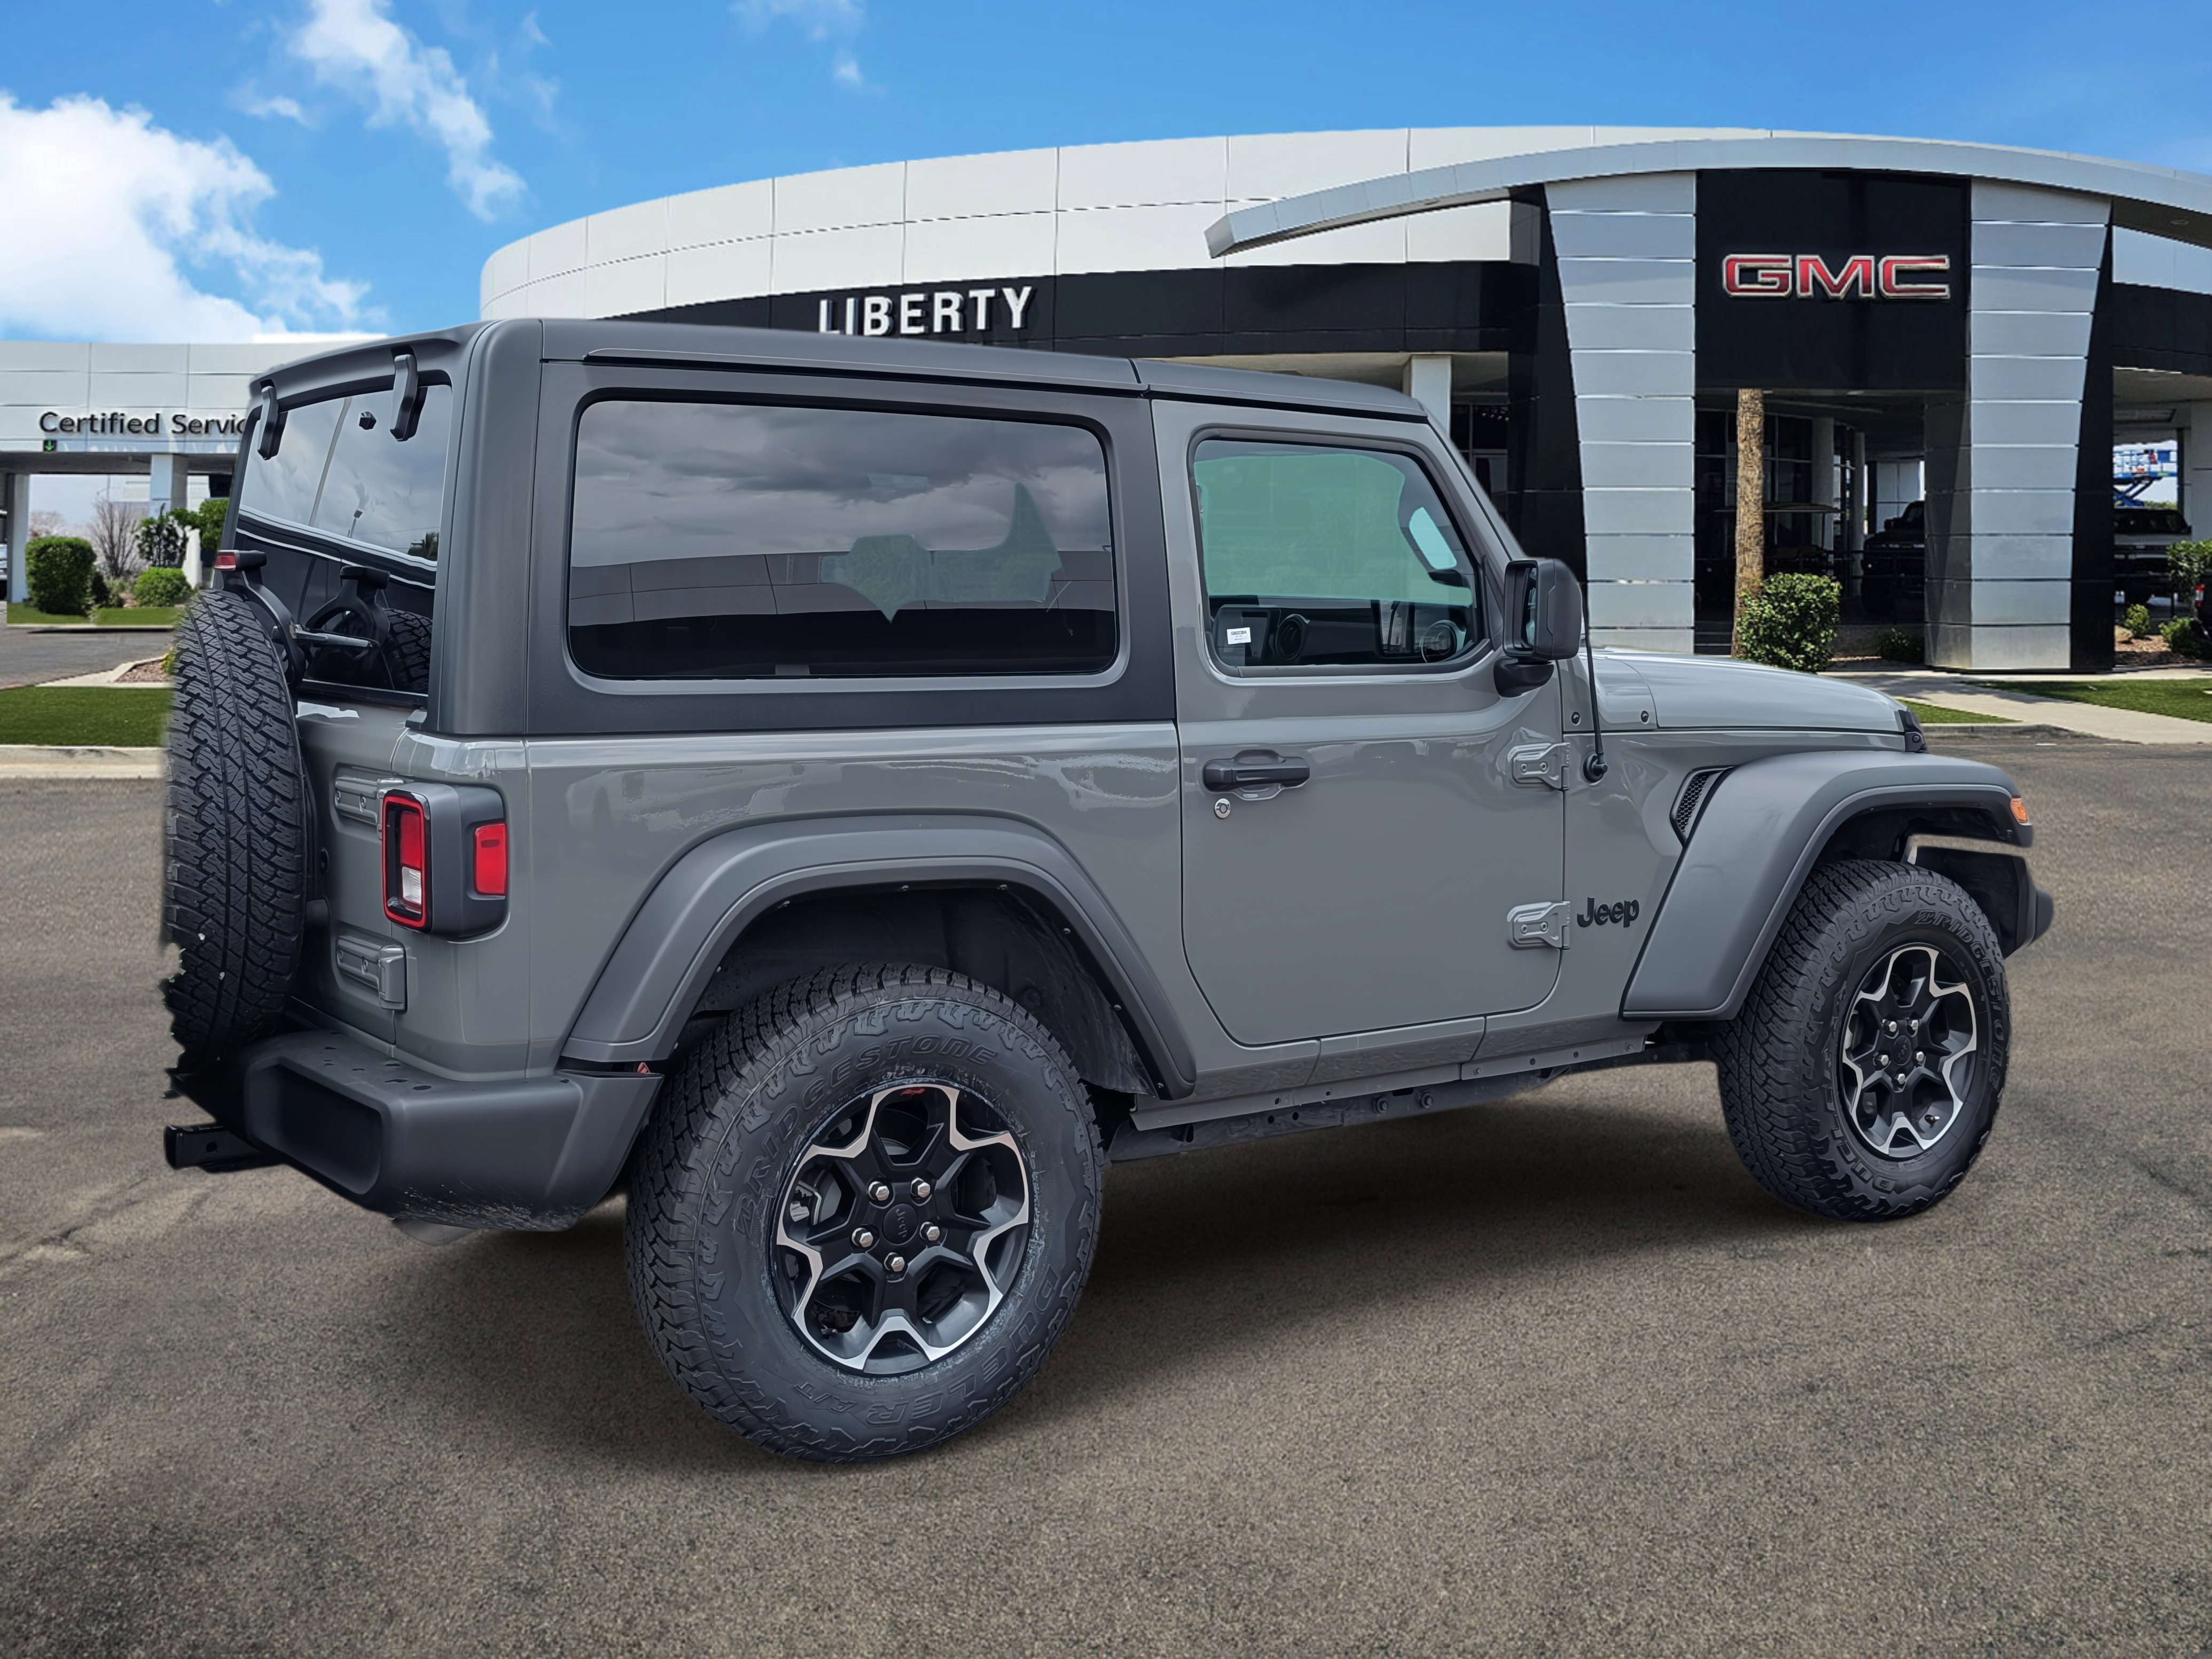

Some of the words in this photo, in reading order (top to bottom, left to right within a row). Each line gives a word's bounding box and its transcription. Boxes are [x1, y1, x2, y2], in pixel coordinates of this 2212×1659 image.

[1722, 254, 1950, 299] GMC
[819, 286, 1033, 336] LIBERTY
[39, 411, 160, 434] Certified
[171, 413, 246, 434] Servic
[1577, 897, 1639, 928] Jeep
[732, 1032, 998, 1235] BRIDGESTONE
[865, 1266, 1059, 1425] DUELER
